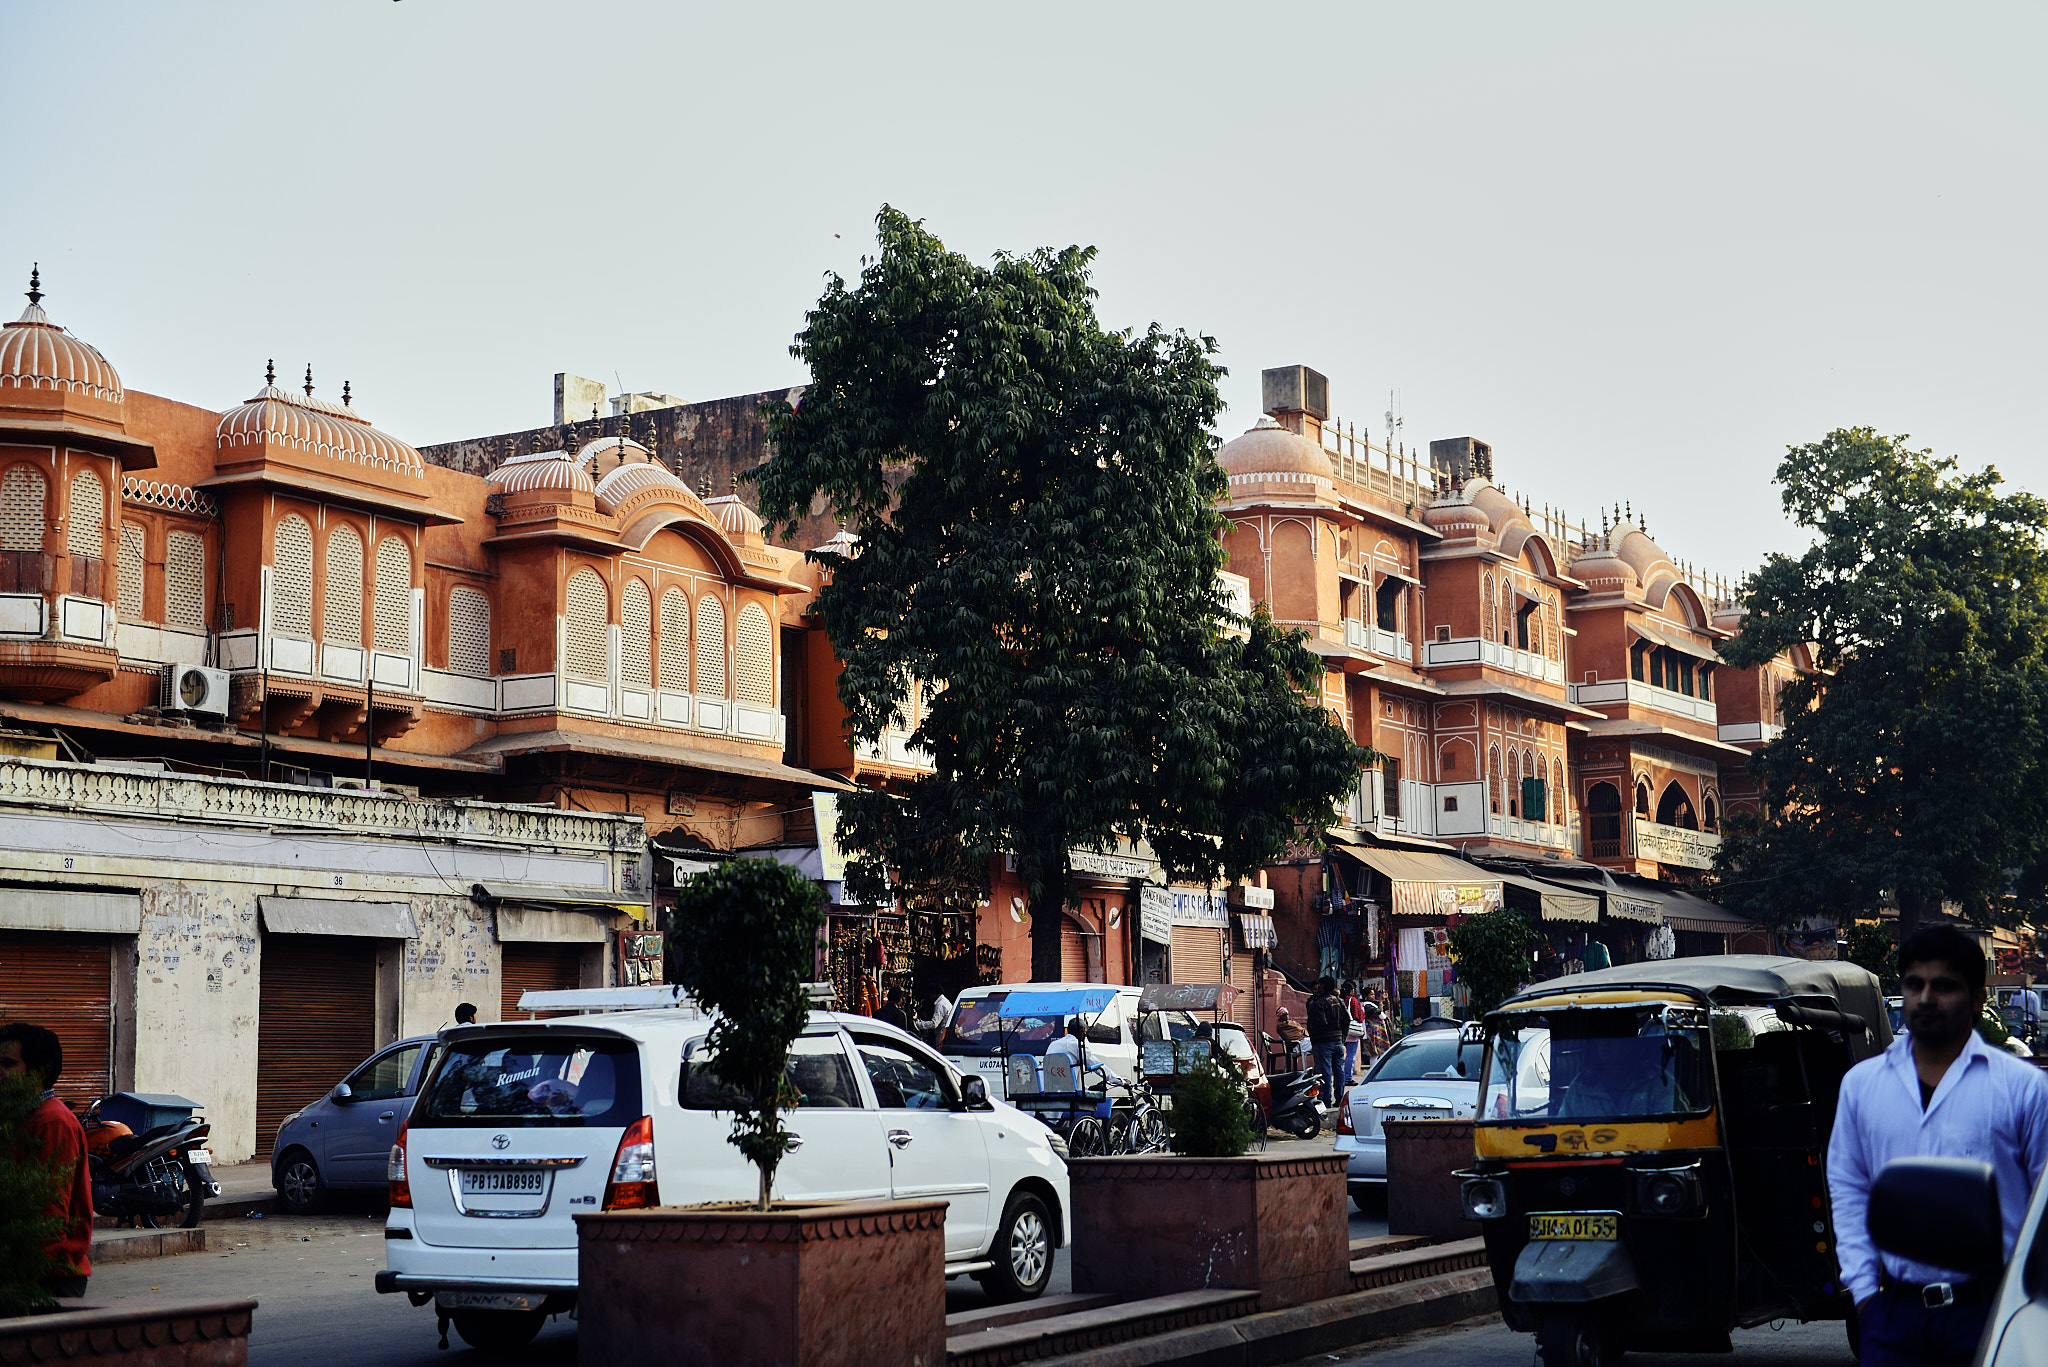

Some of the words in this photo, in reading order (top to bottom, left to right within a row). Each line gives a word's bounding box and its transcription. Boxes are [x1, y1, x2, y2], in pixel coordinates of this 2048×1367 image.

[64, 858, 74, 869] 37
[334, 876, 343, 886] 36
[496, 1066, 540, 1087] Raman
[471, 1174, 542, 1190] PB13AB8989
